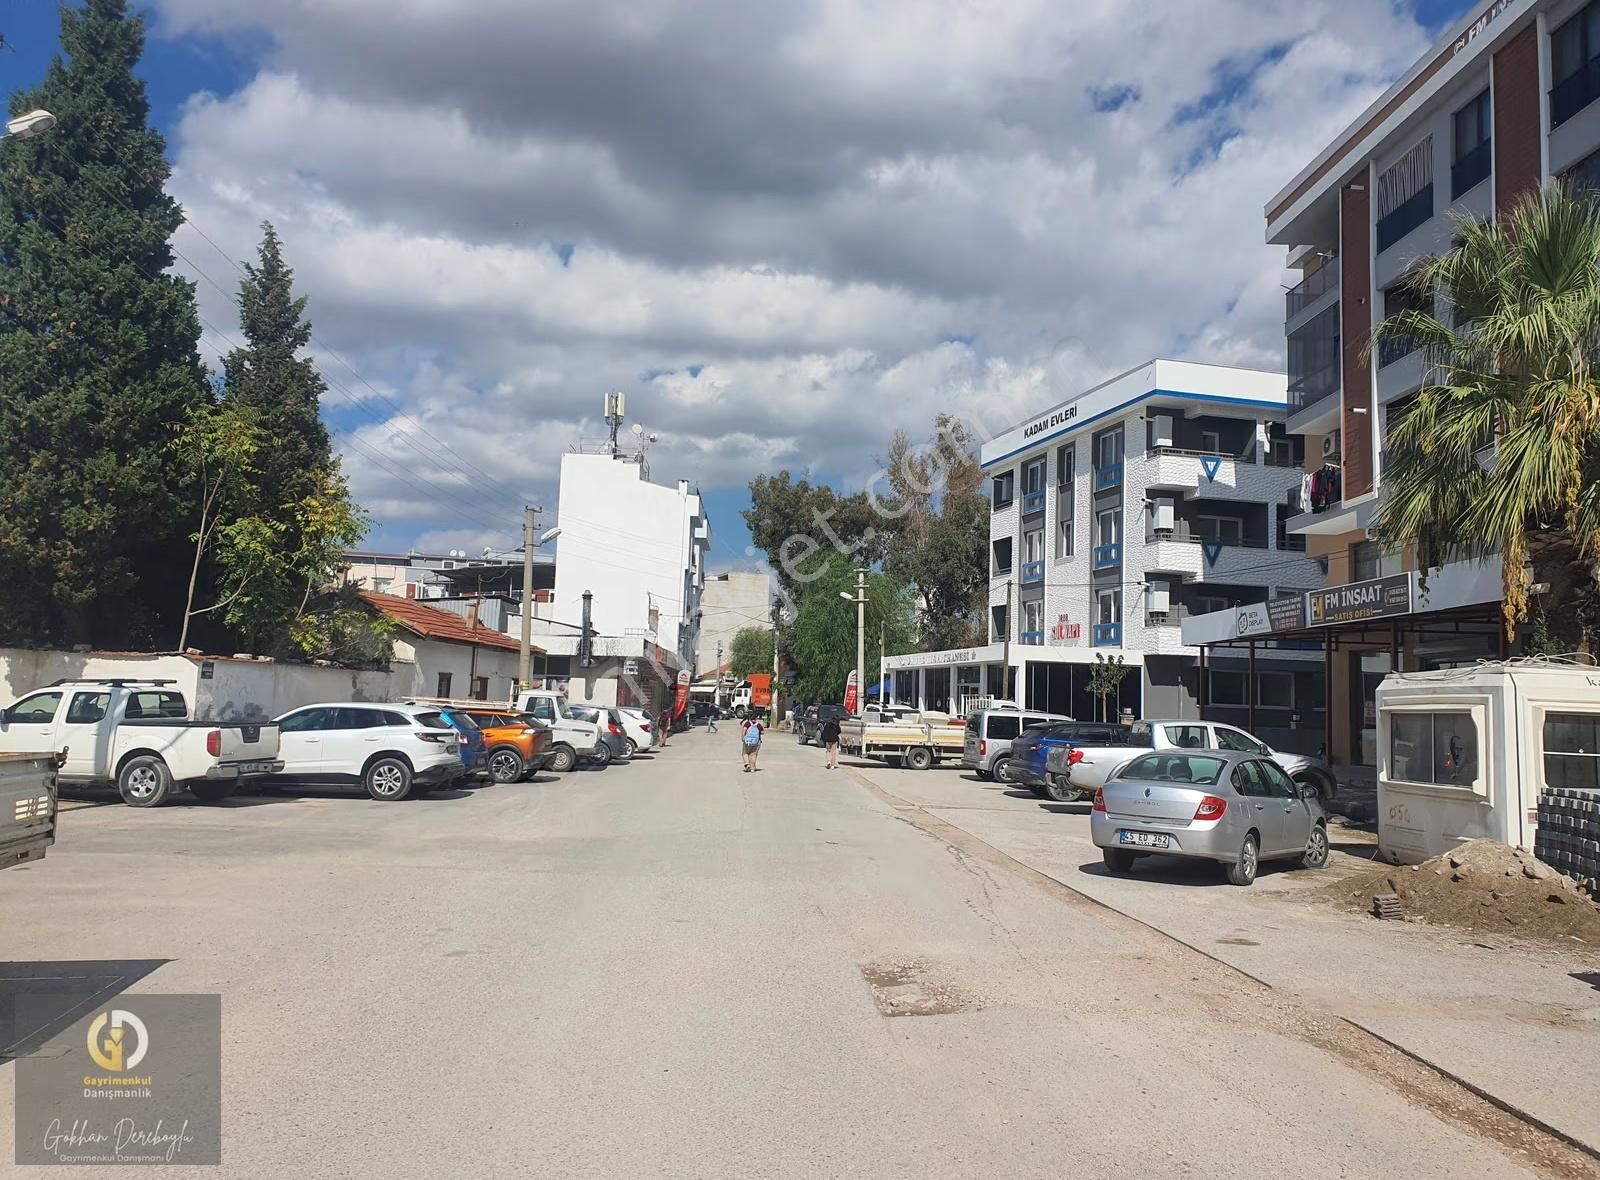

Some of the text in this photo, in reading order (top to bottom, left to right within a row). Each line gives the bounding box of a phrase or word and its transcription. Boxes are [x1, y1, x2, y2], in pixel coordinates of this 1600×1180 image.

[1468, 16, 1487, 43] FM
[1024, 403, 1078, 439] KADAM EVLERİ
[1325, 592, 1339, 609] FM
[1341, 585, 1382, 607] İNŞAAT
[1248, 612, 1258, 620] BETA
[1334, 607, 1373, 621] SATIŞ OFİSİ
[1138, 833, 1148, 842] ED
[1153, 834, 1168, 844] 362
